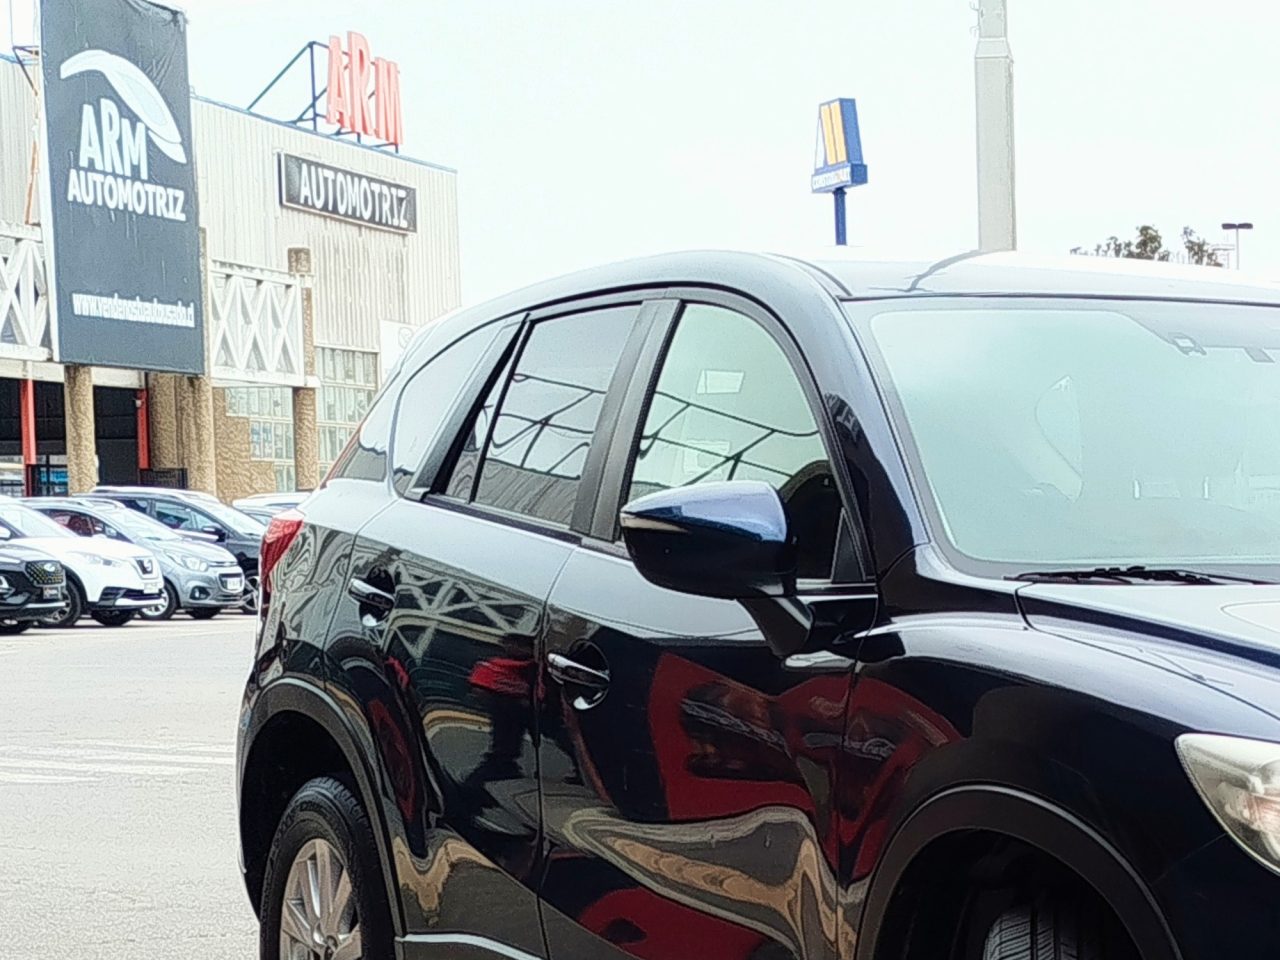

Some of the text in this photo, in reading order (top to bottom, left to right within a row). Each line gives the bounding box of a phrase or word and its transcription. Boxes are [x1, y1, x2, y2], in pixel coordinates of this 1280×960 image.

[326, 31, 403, 145] ARM
[79, 98, 148, 180] ARM
[67, 168, 187, 221] AUTOMOTRIZ
[300, 163, 409, 228] AUTOMOTRIZ
